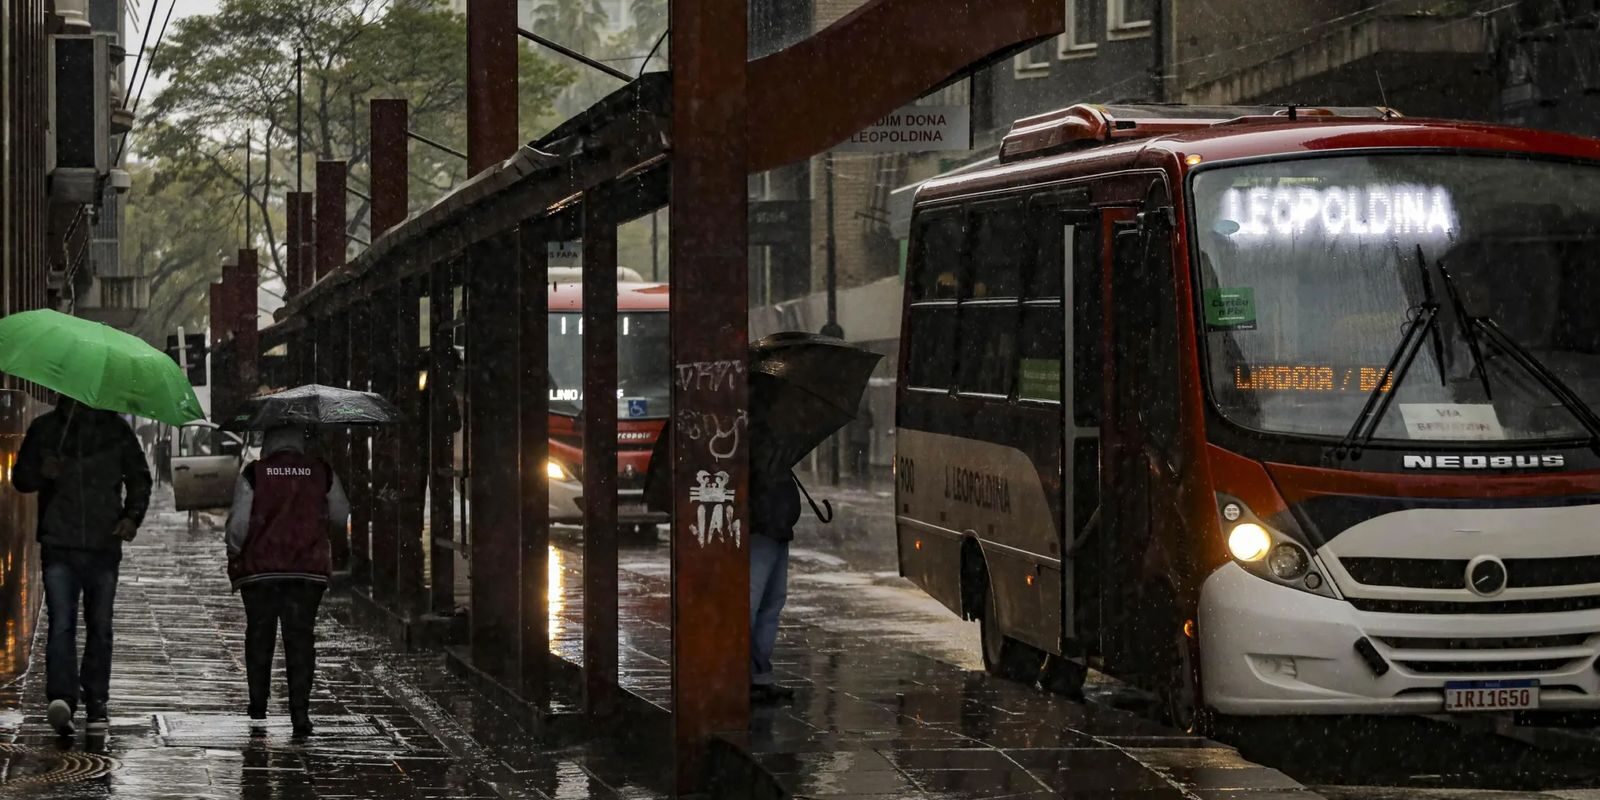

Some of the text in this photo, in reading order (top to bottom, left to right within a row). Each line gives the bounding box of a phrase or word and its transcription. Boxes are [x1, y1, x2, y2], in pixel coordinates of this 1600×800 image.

[873, 114, 947, 127] DIM DONA
[850, 130, 943, 143] LEOPOLDINA
[1227, 189, 1453, 235] LEOPOLDINA
[549, 388, 579, 401] LINIO
[1403, 455, 1565, 469] NEOBUS
[266, 467, 311, 476] ROLHANO
[1454, 689, 1530, 708] IRI1G50
